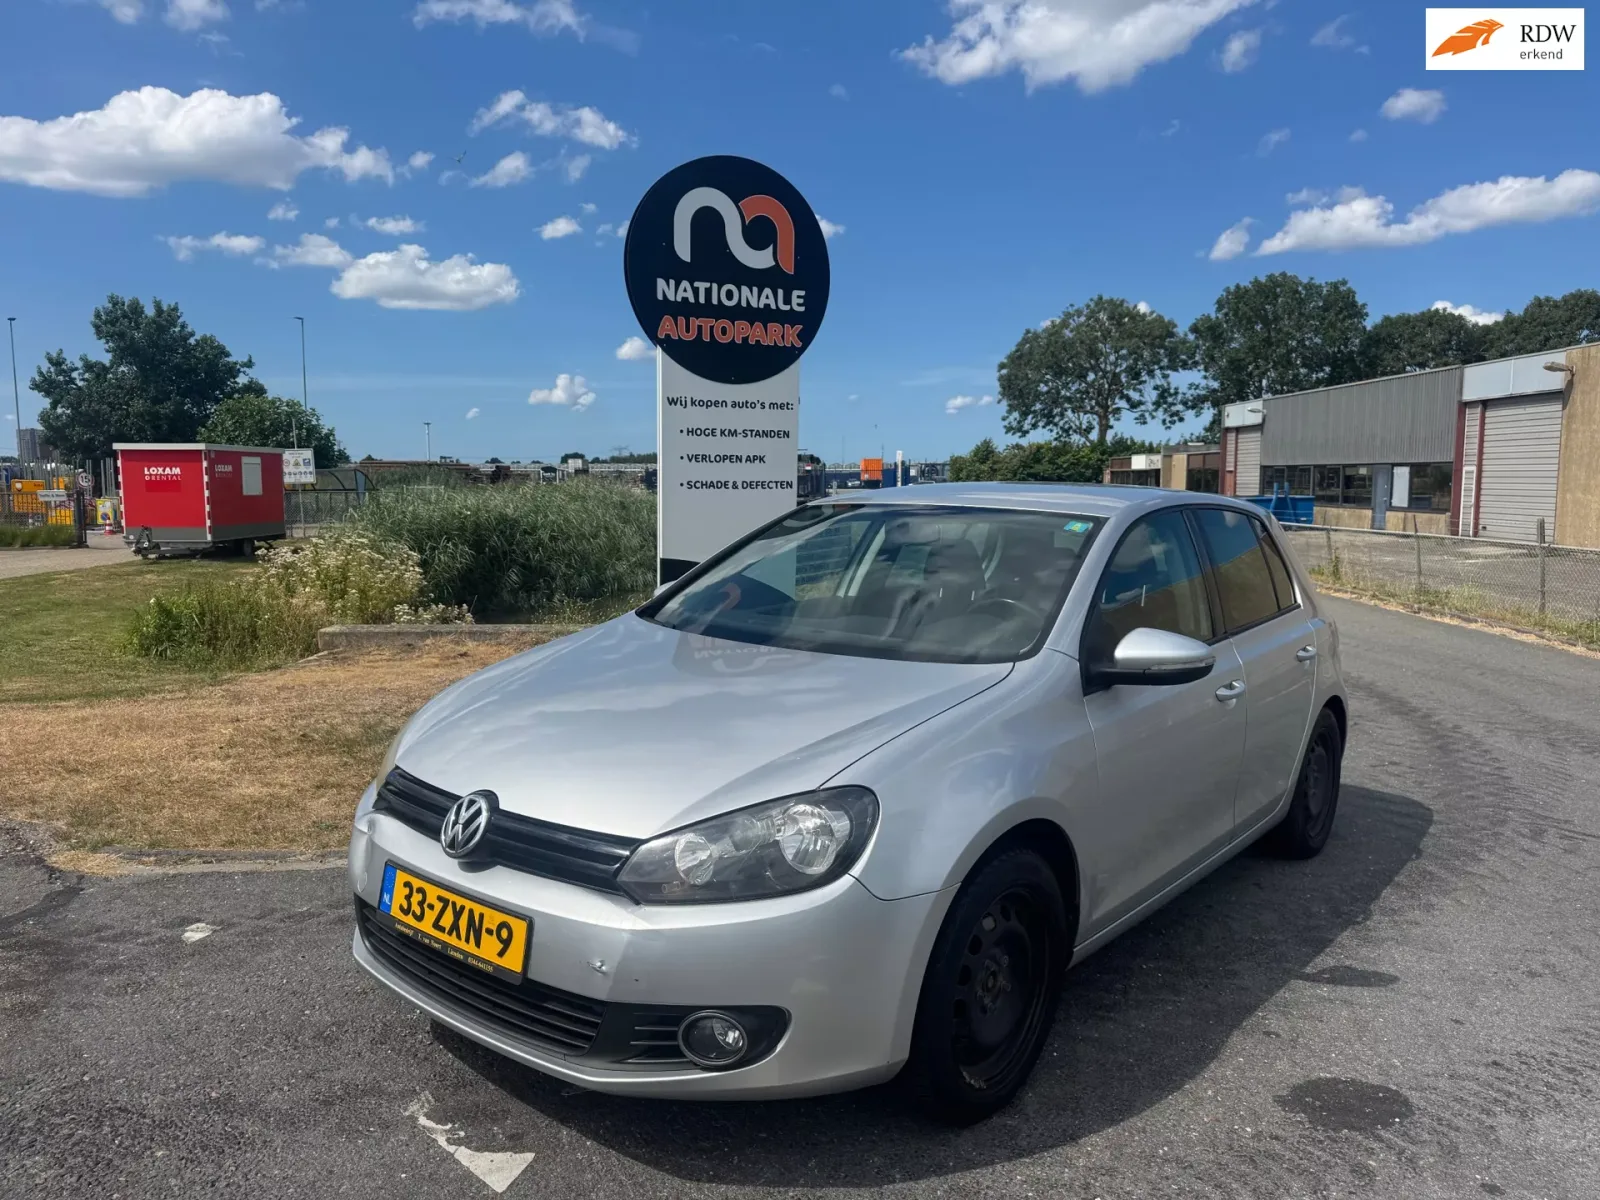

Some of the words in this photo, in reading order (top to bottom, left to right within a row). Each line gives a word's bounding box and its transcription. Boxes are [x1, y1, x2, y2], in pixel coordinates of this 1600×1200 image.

[656, 277, 806, 312] NATIONALE
[657, 315, 804, 348] AUTOPARK
[666, 396, 688, 409] Wij
[690, 396, 728, 410] kopen
[730, 399, 766, 410] auto's
[768, 401, 794, 411] met:
[686, 427, 718, 438] HOGE
[719, 428, 790, 439] KM-STANDEN
[686, 453, 743, 464] VERLOPEN
[744, 454, 766, 464] APK
[143, 466, 181, 475] LOXAM
[686, 480, 730, 490] SCHADE
[731, 480, 739, 490] &
[741, 480, 793, 490] DEFECTEN
[382, 892, 391, 905] NL
[399, 881, 513, 958] 33-ZXN-9
